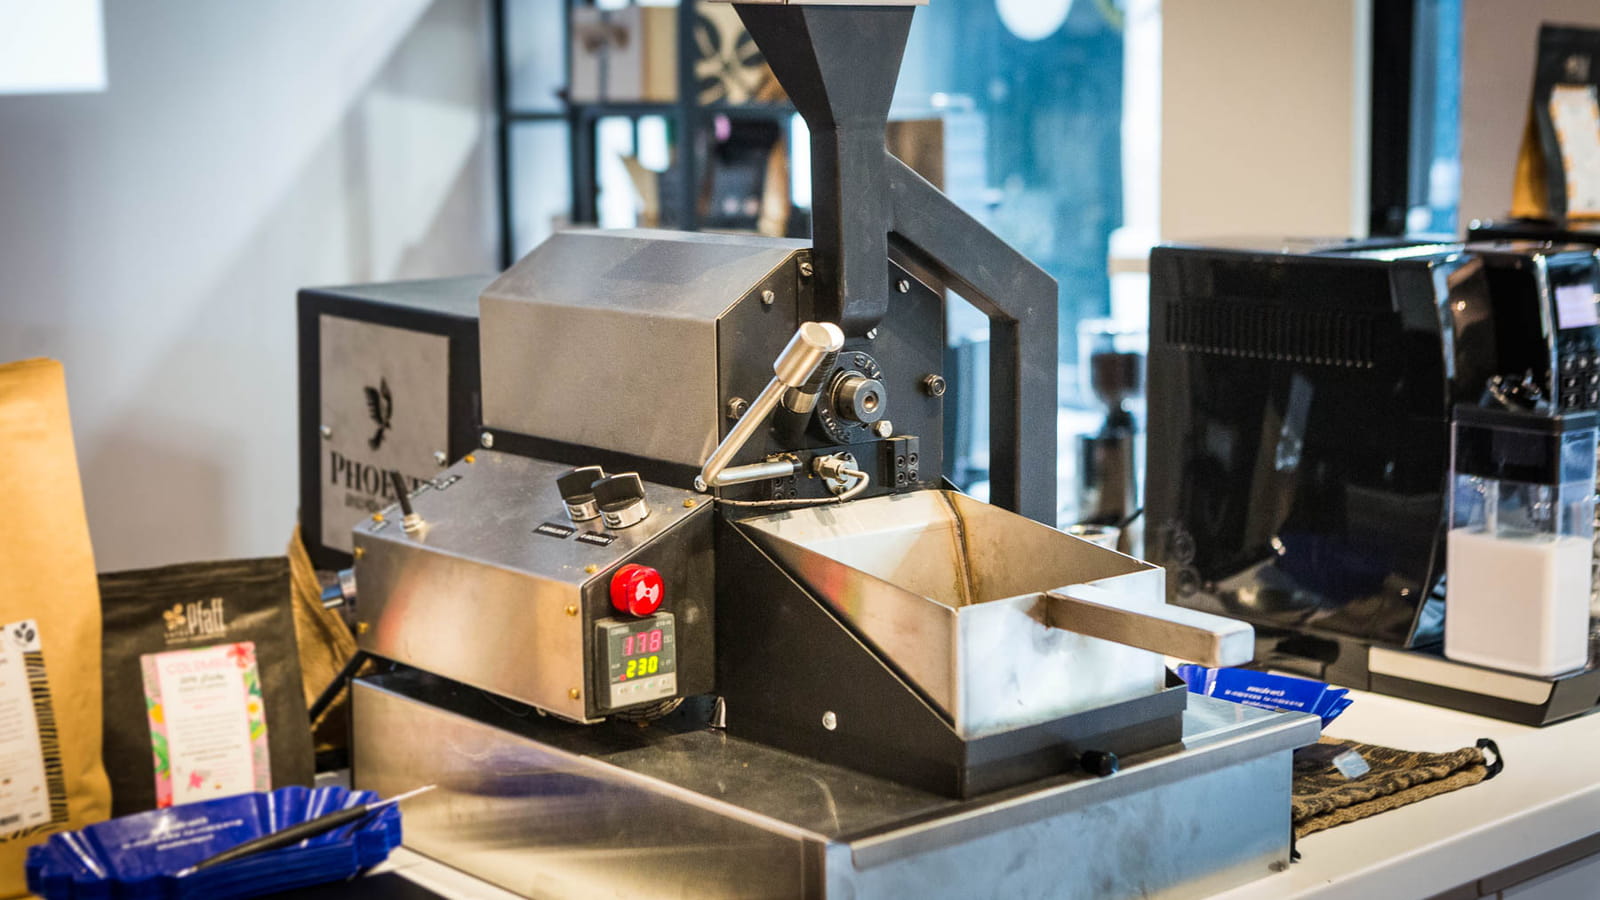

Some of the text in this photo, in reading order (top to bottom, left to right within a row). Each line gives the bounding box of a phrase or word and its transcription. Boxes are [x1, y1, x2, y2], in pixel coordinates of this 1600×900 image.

[331, 451, 434, 500] PHOE
[186, 598, 224, 634] Pfaff
[625, 629, 663, 656] 178
[626, 655, 659, 678] 230
